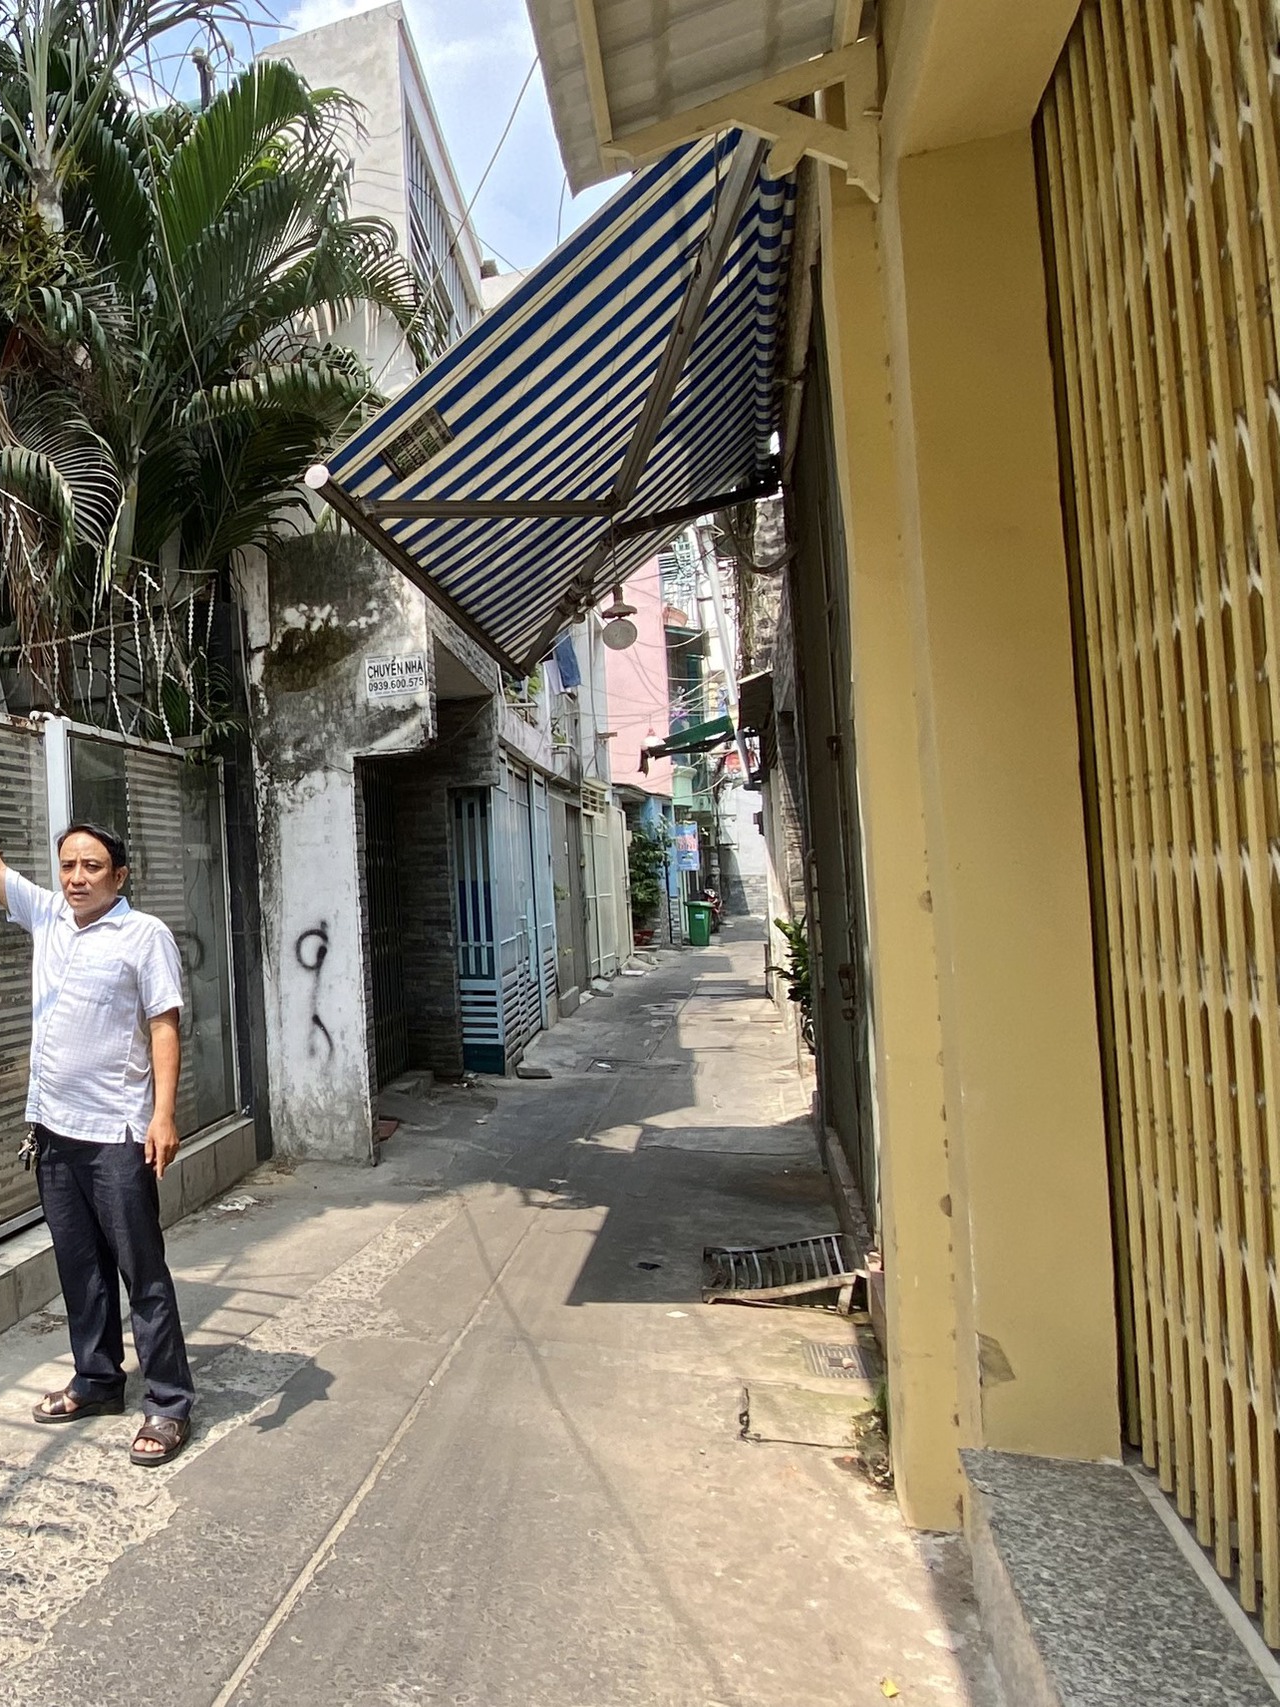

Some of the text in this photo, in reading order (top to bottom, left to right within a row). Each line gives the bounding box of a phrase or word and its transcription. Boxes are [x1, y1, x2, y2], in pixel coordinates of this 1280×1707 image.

[367, 655, 424, 678] CHUYỂN NHÀ
[368, 677, 424, 692] 0939.600.575
